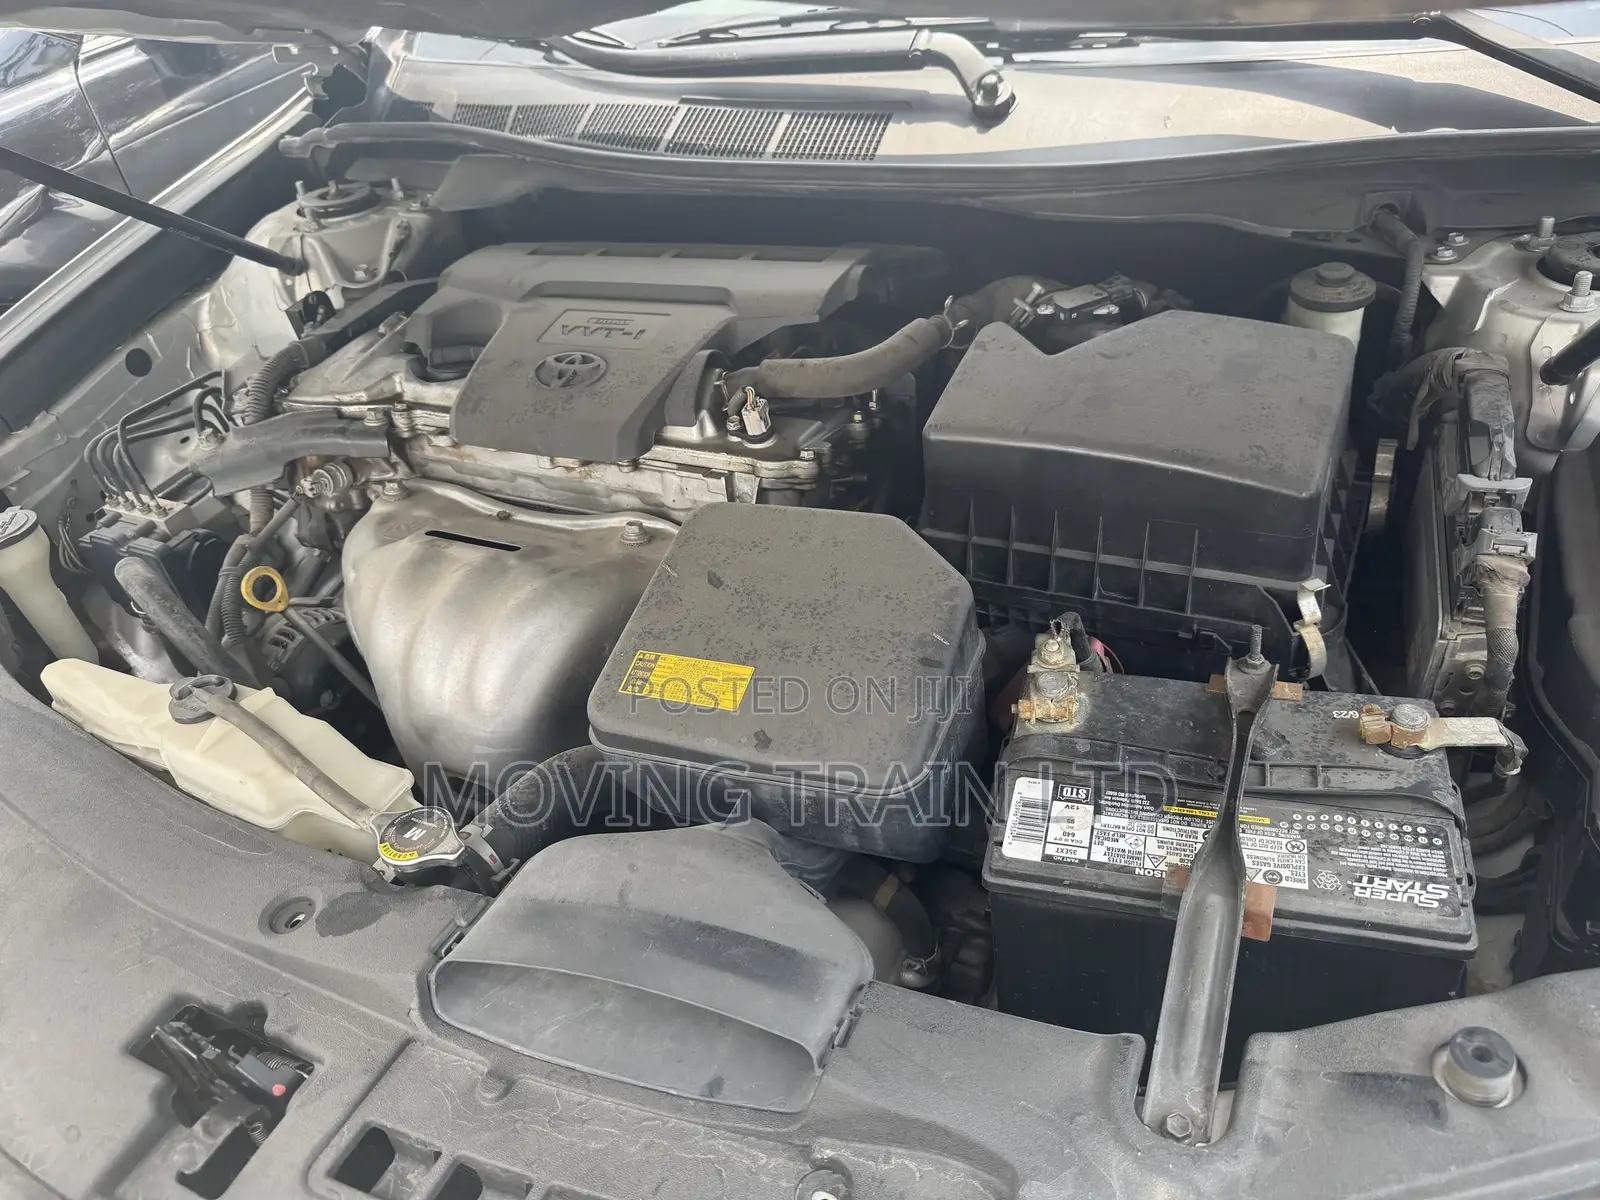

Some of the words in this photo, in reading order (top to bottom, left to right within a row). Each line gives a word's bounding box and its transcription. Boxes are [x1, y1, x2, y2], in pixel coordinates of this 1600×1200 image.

[1332, 710, 1360, 718] 6/23
[1062, 787, 1088, 799] STD
[1093, 834, 1119, 842] MEDICAL
[382, 844, 408, 859] CAUTION
[1104, 845, 1126, 853] WATER.
[1164, 844, 1194, 852] BLINDNESS
[1102, 851, 1142, 860] IMMEDIATELY
[1273, 863, 1305, 871] EXPLOSIVE
[1134, 867, 1165, 877] ISON
[1353, 876, 1450, 899] START
[1354, 886, 1439, 908] SUPER
